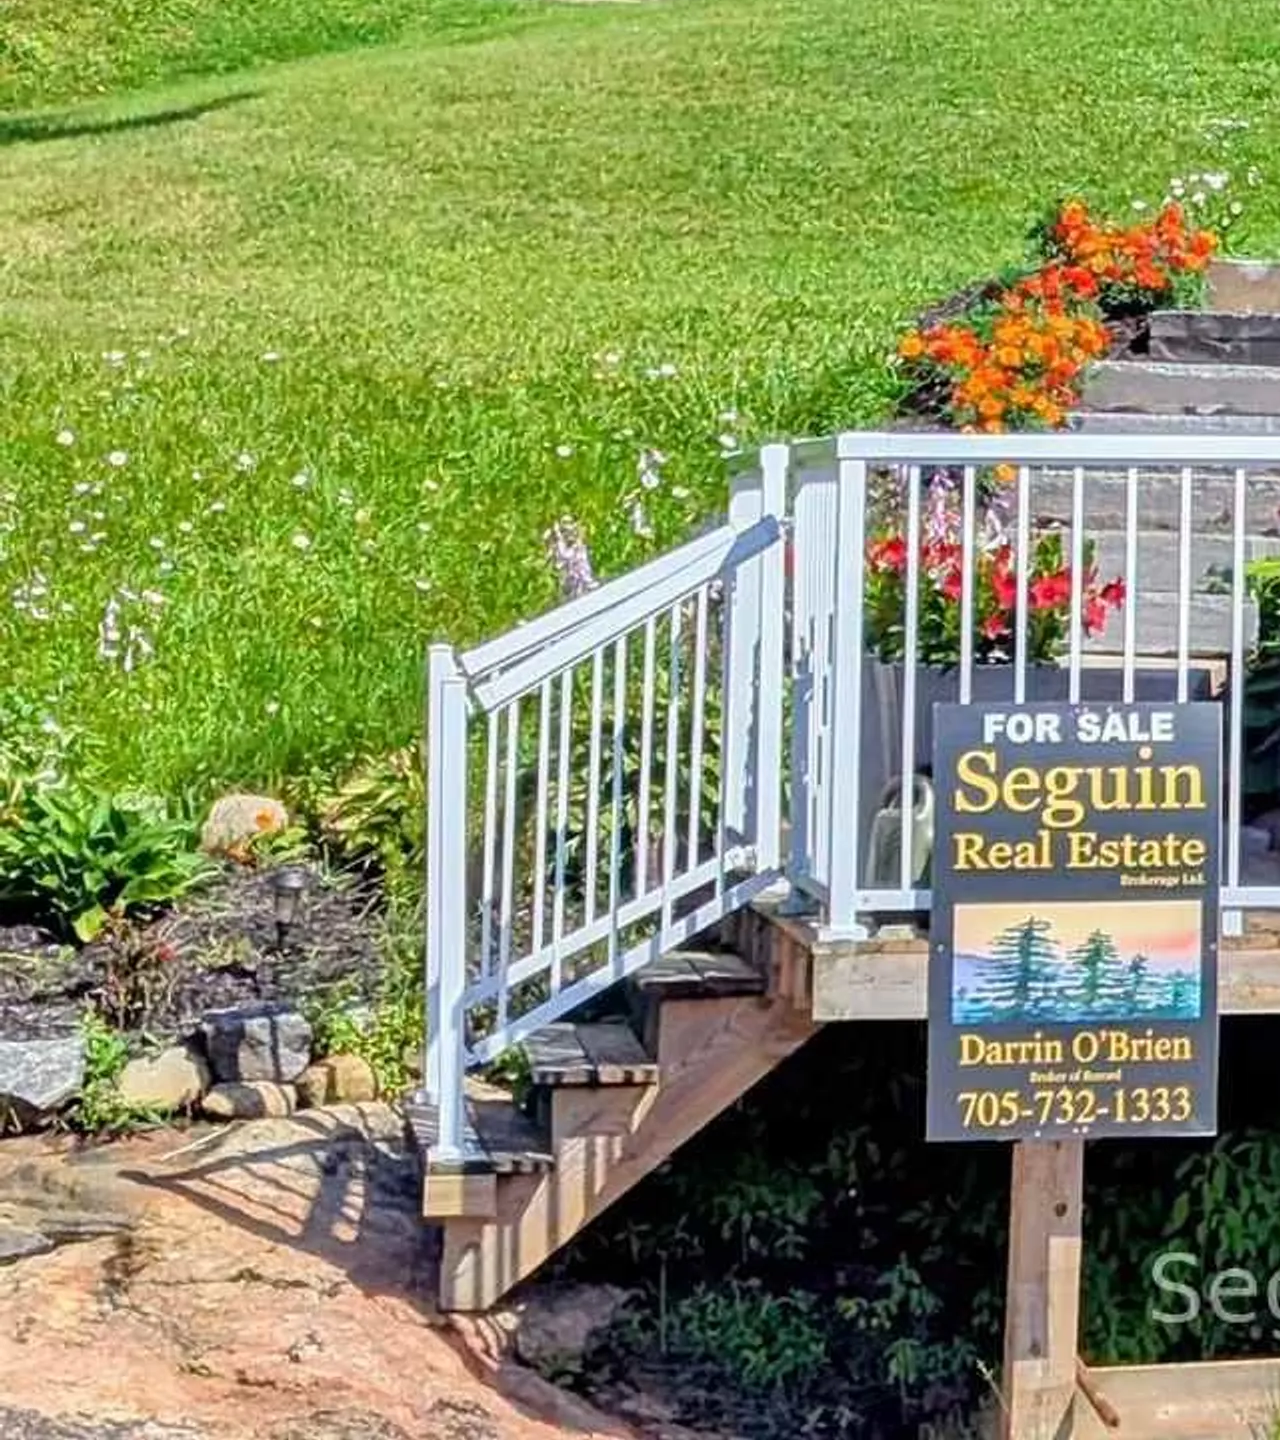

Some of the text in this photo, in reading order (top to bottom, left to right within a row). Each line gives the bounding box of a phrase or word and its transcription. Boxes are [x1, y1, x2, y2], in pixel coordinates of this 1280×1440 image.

[983, 711, 1175, 743] FOR SALE
[953, 746, 1206, 828] Seguin
[953, 831, 1206, 870] Real Estate
[959, 1029, 1192, 1066] Darrin O'Brien
[957, 1086, 1192, 1128] 705-732-1333
